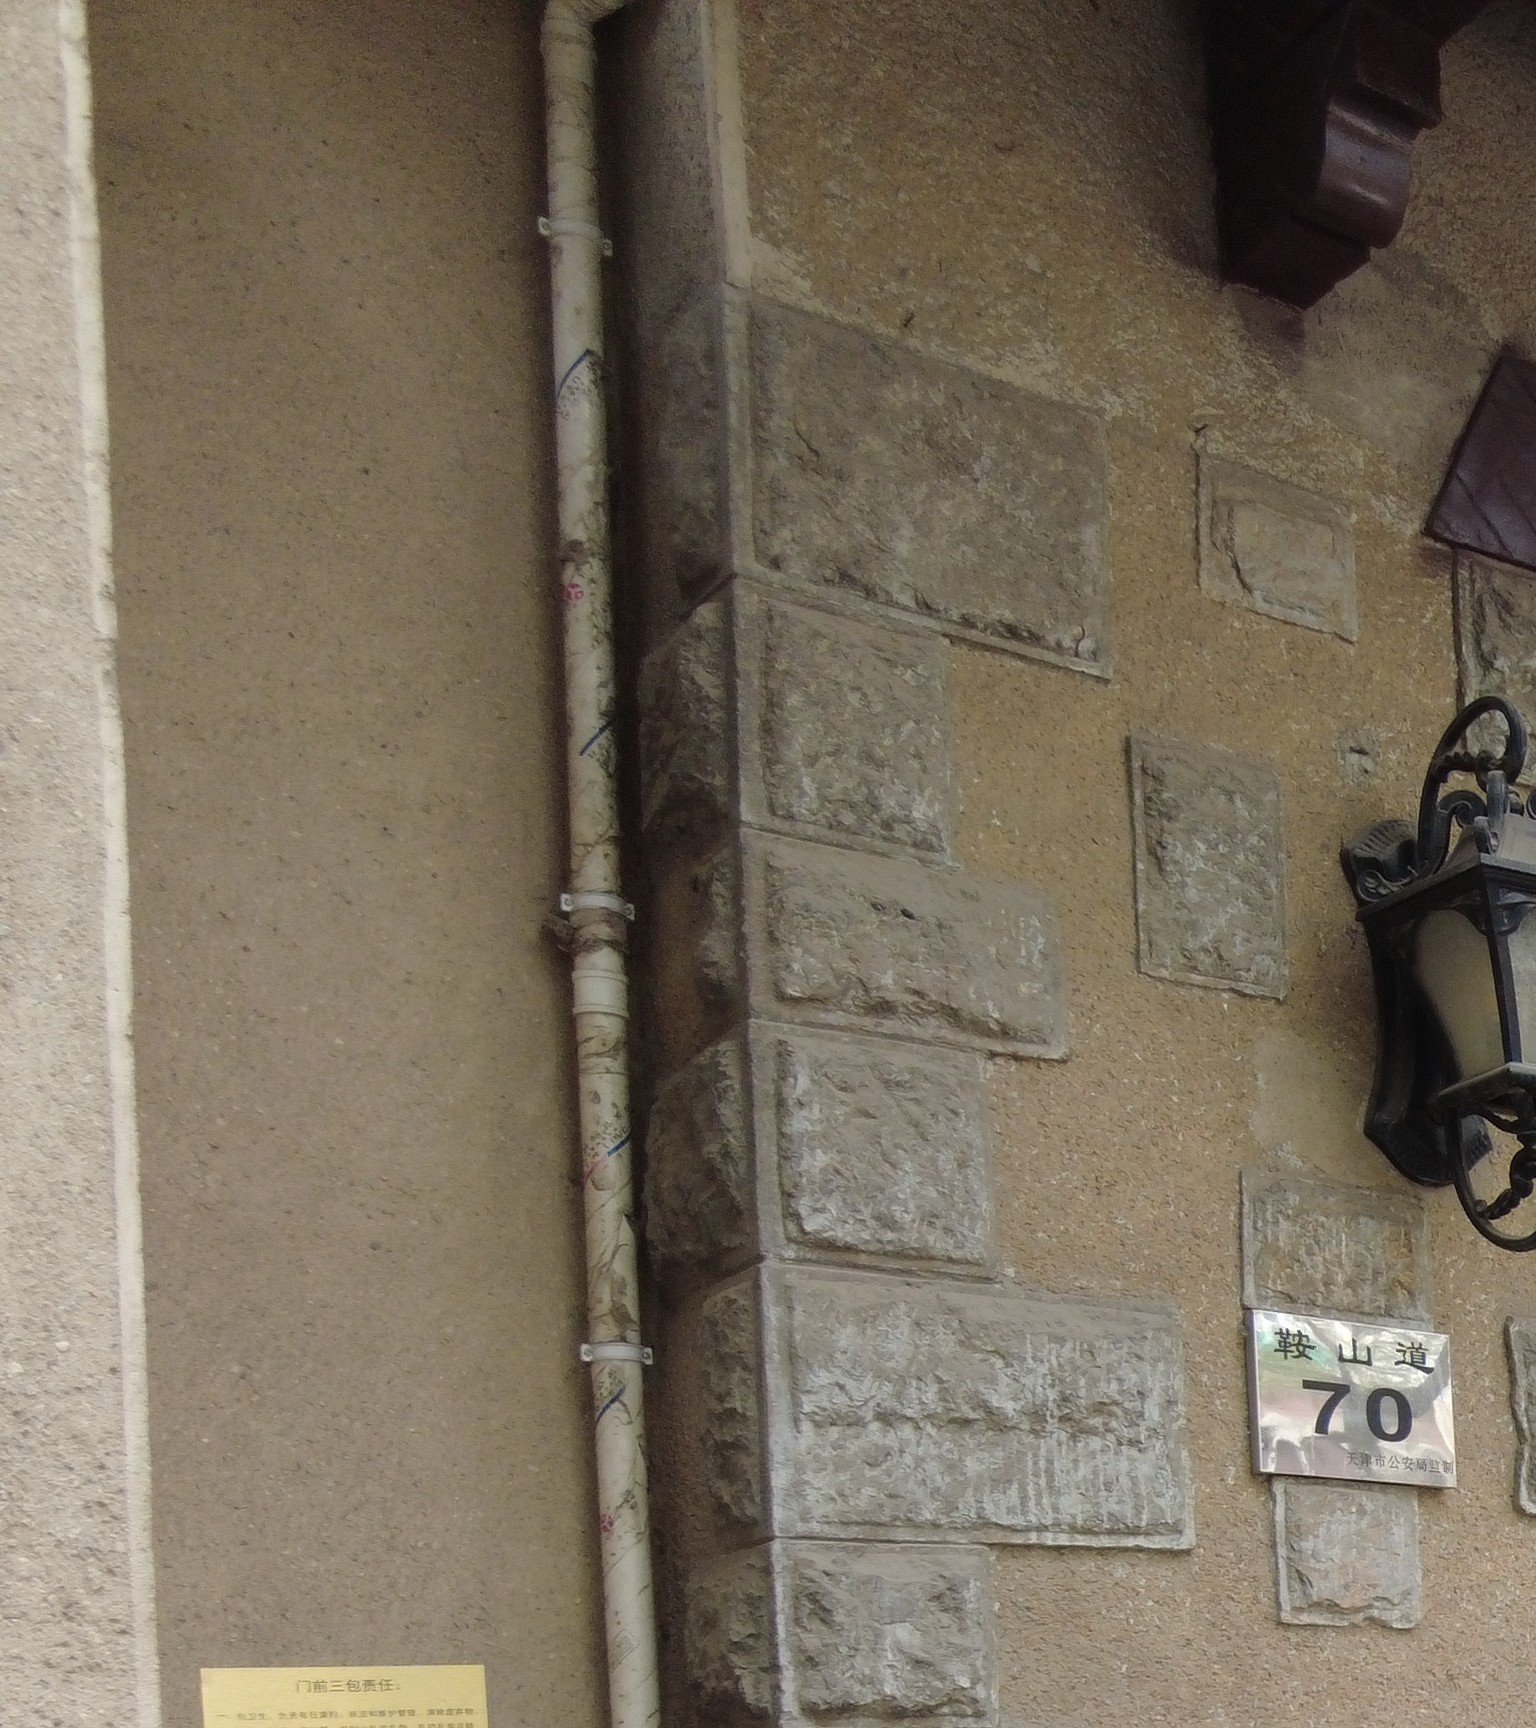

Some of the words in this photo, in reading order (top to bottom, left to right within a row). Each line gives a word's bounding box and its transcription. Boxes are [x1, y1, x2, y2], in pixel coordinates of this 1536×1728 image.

[1274, 1328, 1434, 1374] 鞍山道
[1302, 1379, 1412, 1442] 70
[1346, 1452, 1454, 1474] 天津市公安局监制
